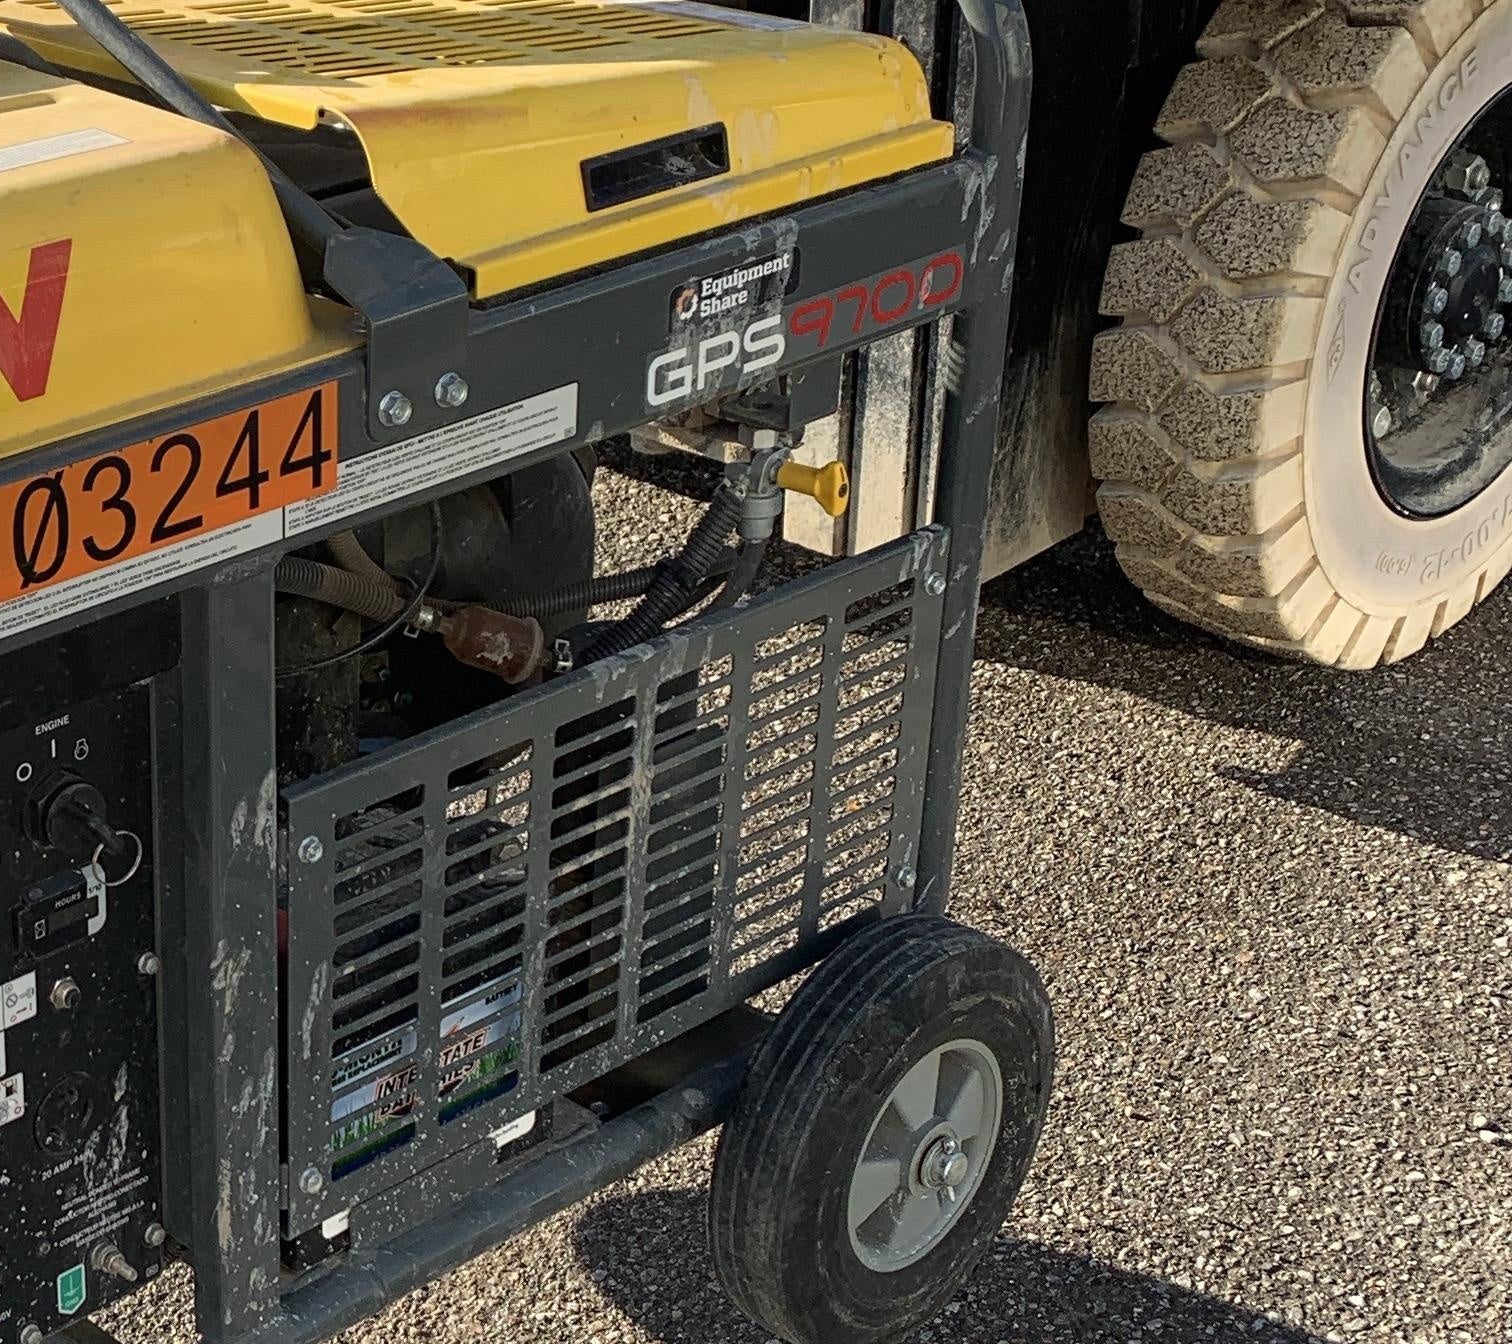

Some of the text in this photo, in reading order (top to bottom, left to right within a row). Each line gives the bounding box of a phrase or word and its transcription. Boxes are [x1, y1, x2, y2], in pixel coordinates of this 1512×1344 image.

[1346, 45, 1479, 295] ADVANCE
[700, 252, 791, 298] Equipment
[699, 290, 748, 318] Share
[34, 714, 71, 736] ENGINE
[54, 891, 82, 909] HOURS
[87, 882, 102, 895] 1/10
[41, 1158, 73, 1182] 20 AMP
